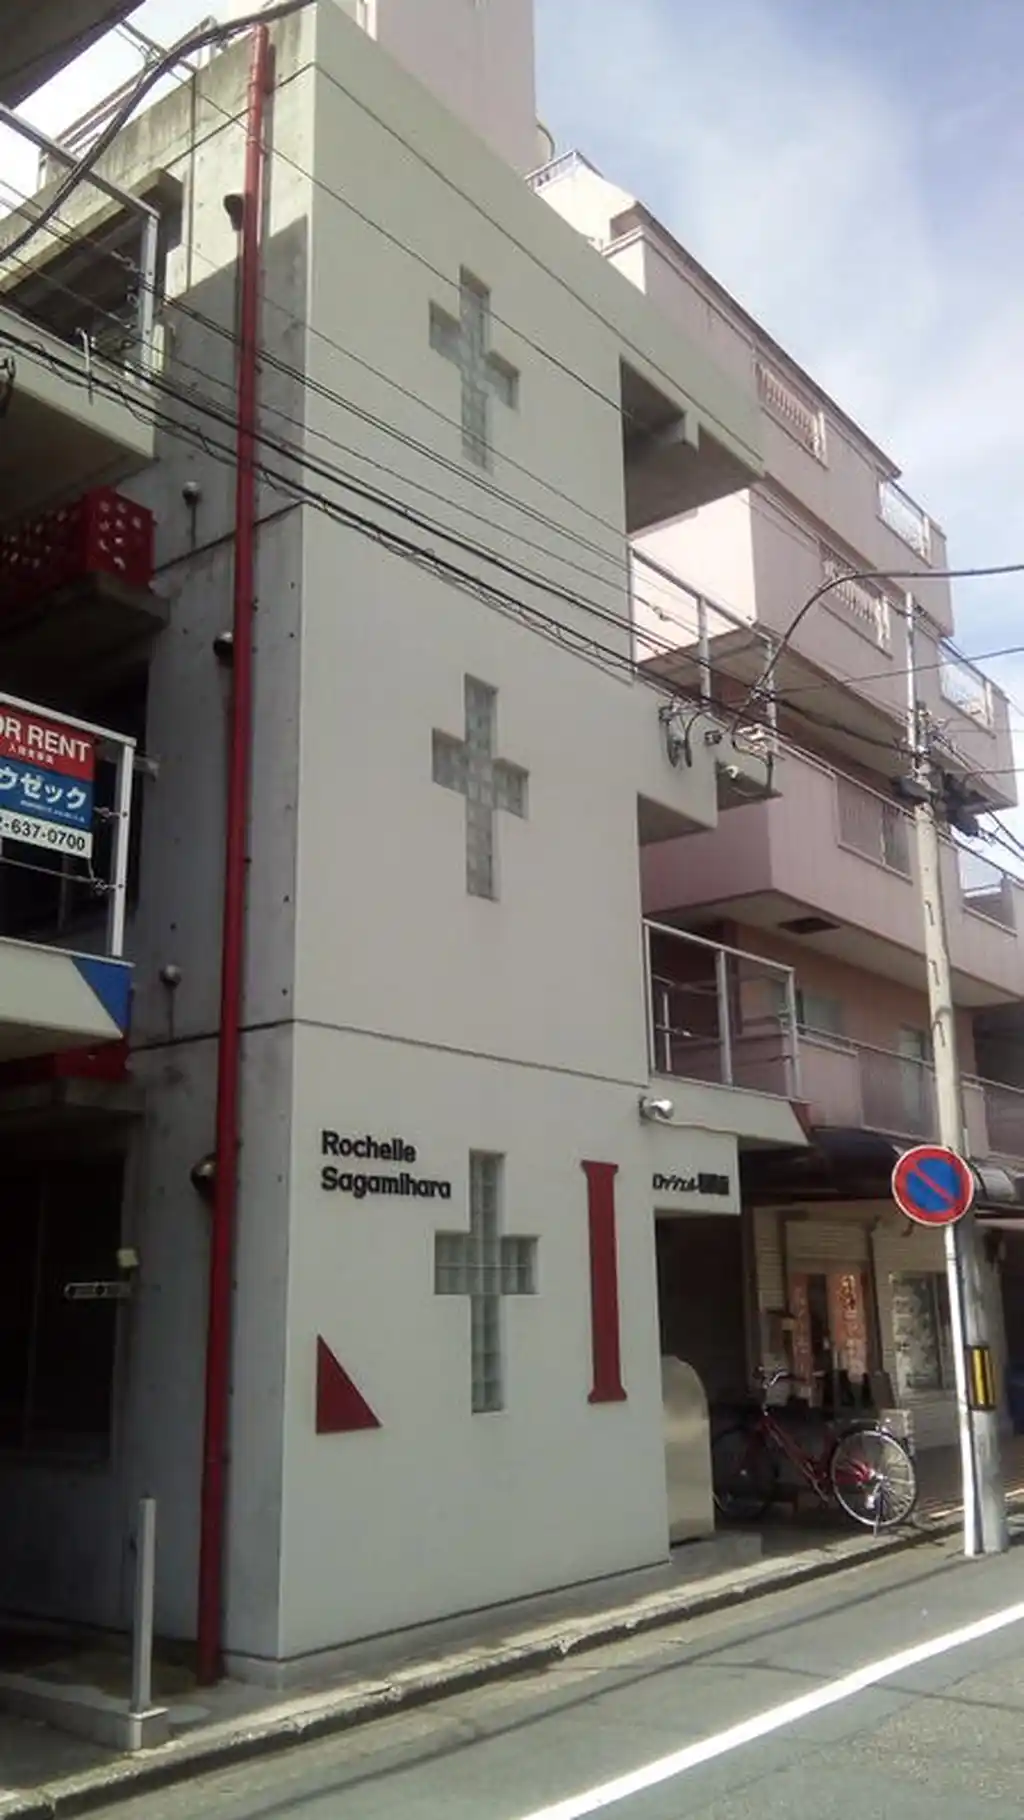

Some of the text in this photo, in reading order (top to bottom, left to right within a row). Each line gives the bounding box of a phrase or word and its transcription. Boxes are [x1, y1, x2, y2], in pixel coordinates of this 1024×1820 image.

[28, 724, 91, 762] RENT
[0, 817, 85, 851] -637-0700
[322, 1130, 416, 1163] Rochelle
[321, 1166, 451, 1199] Sagamihara
